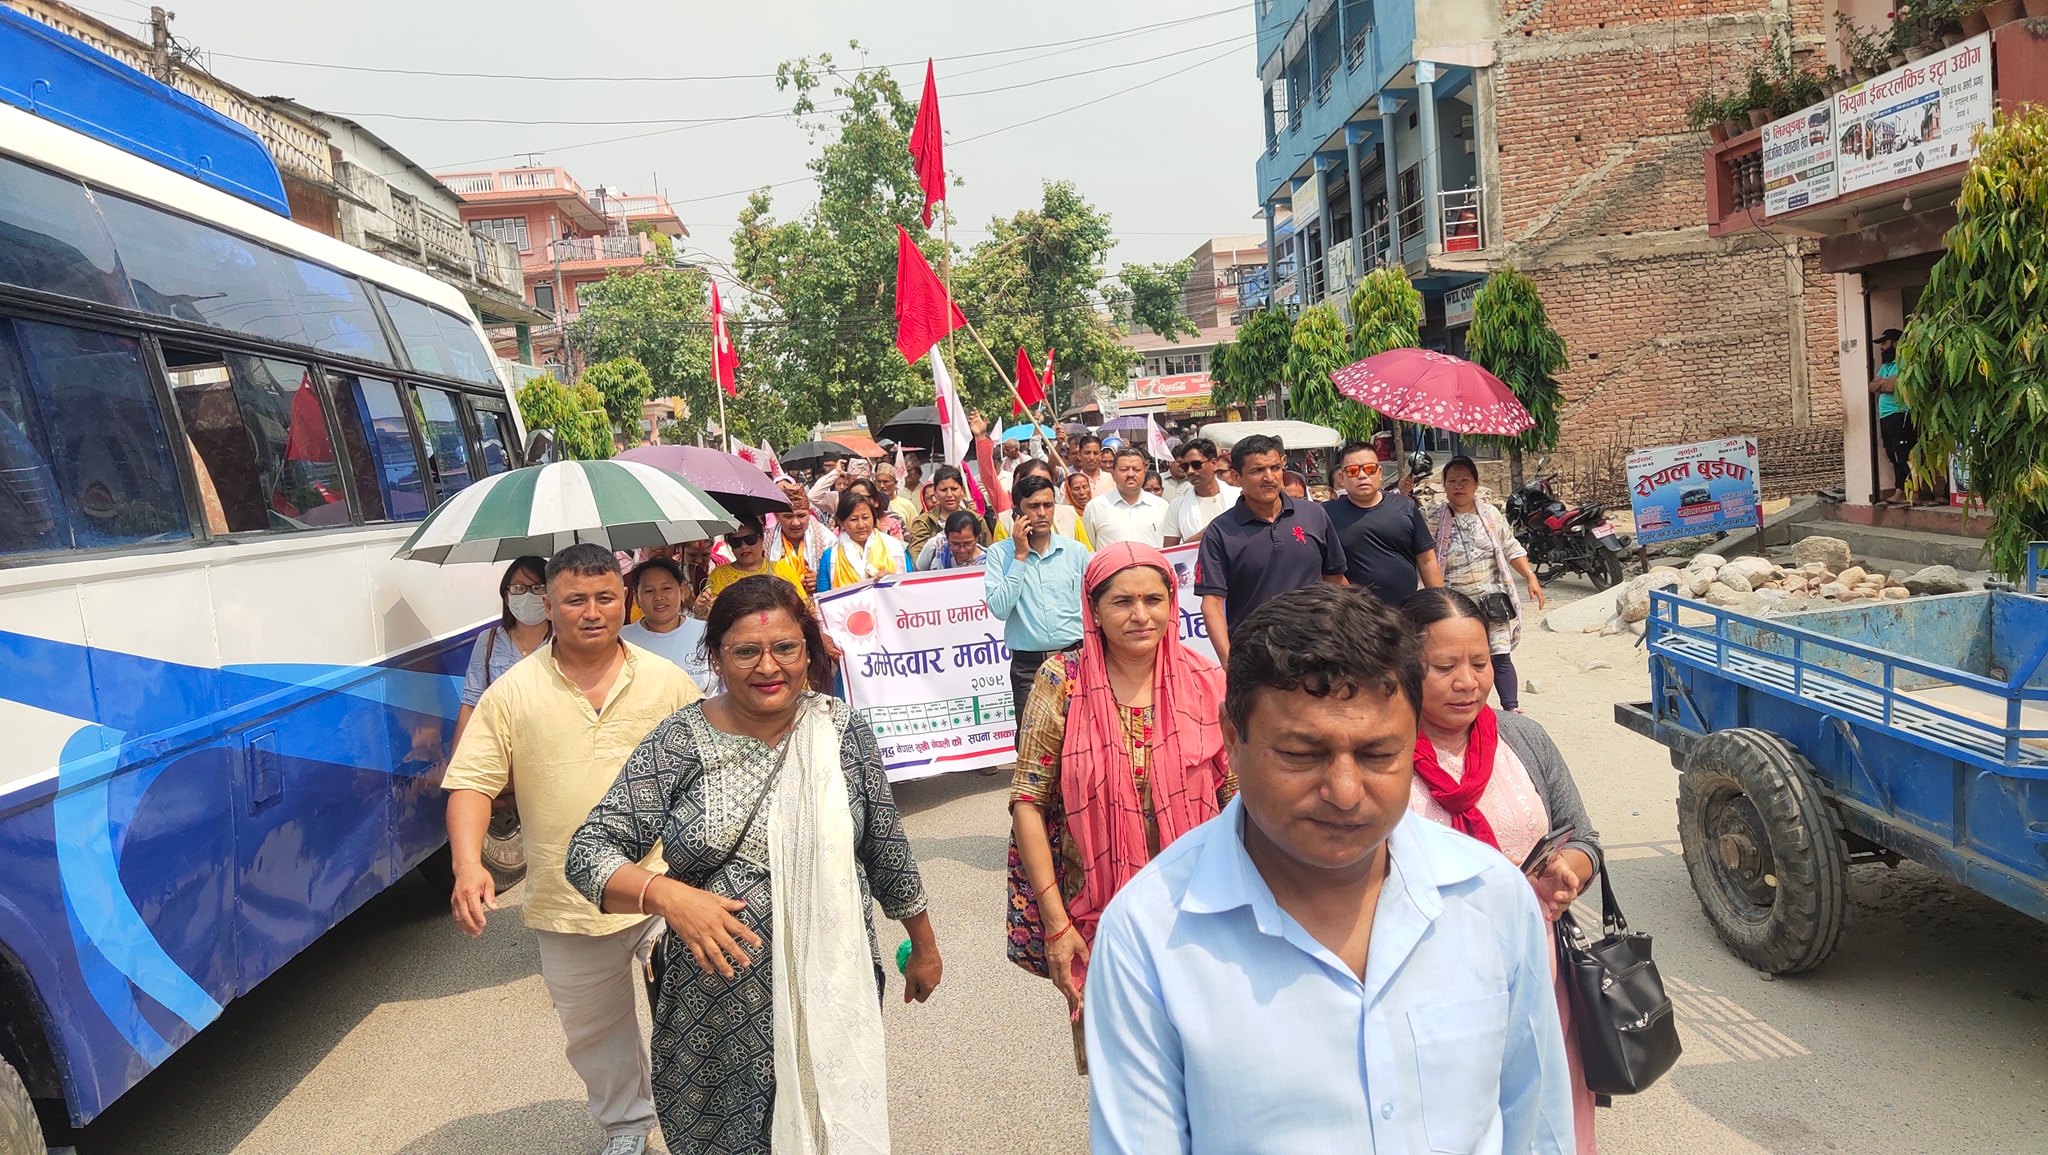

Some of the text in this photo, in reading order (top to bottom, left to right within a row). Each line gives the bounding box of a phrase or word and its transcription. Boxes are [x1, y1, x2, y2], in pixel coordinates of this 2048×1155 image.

[1839, 91, 1867, 114] त्रियुगा
[1951, 46, 1981, 73] उद्योग
[1634, 457, 1748, 497] रोयल बुईपा
[895, 599, 989, 630] नेकपा एमाले
[859, 644, 945, 680] उम्मेदवार
[971, 674, 1005, 691] २०७९
[952, 736, 962, 747] को
[968, 731, 991, 745] सपना
[993, 729, 1016, 741] साका
